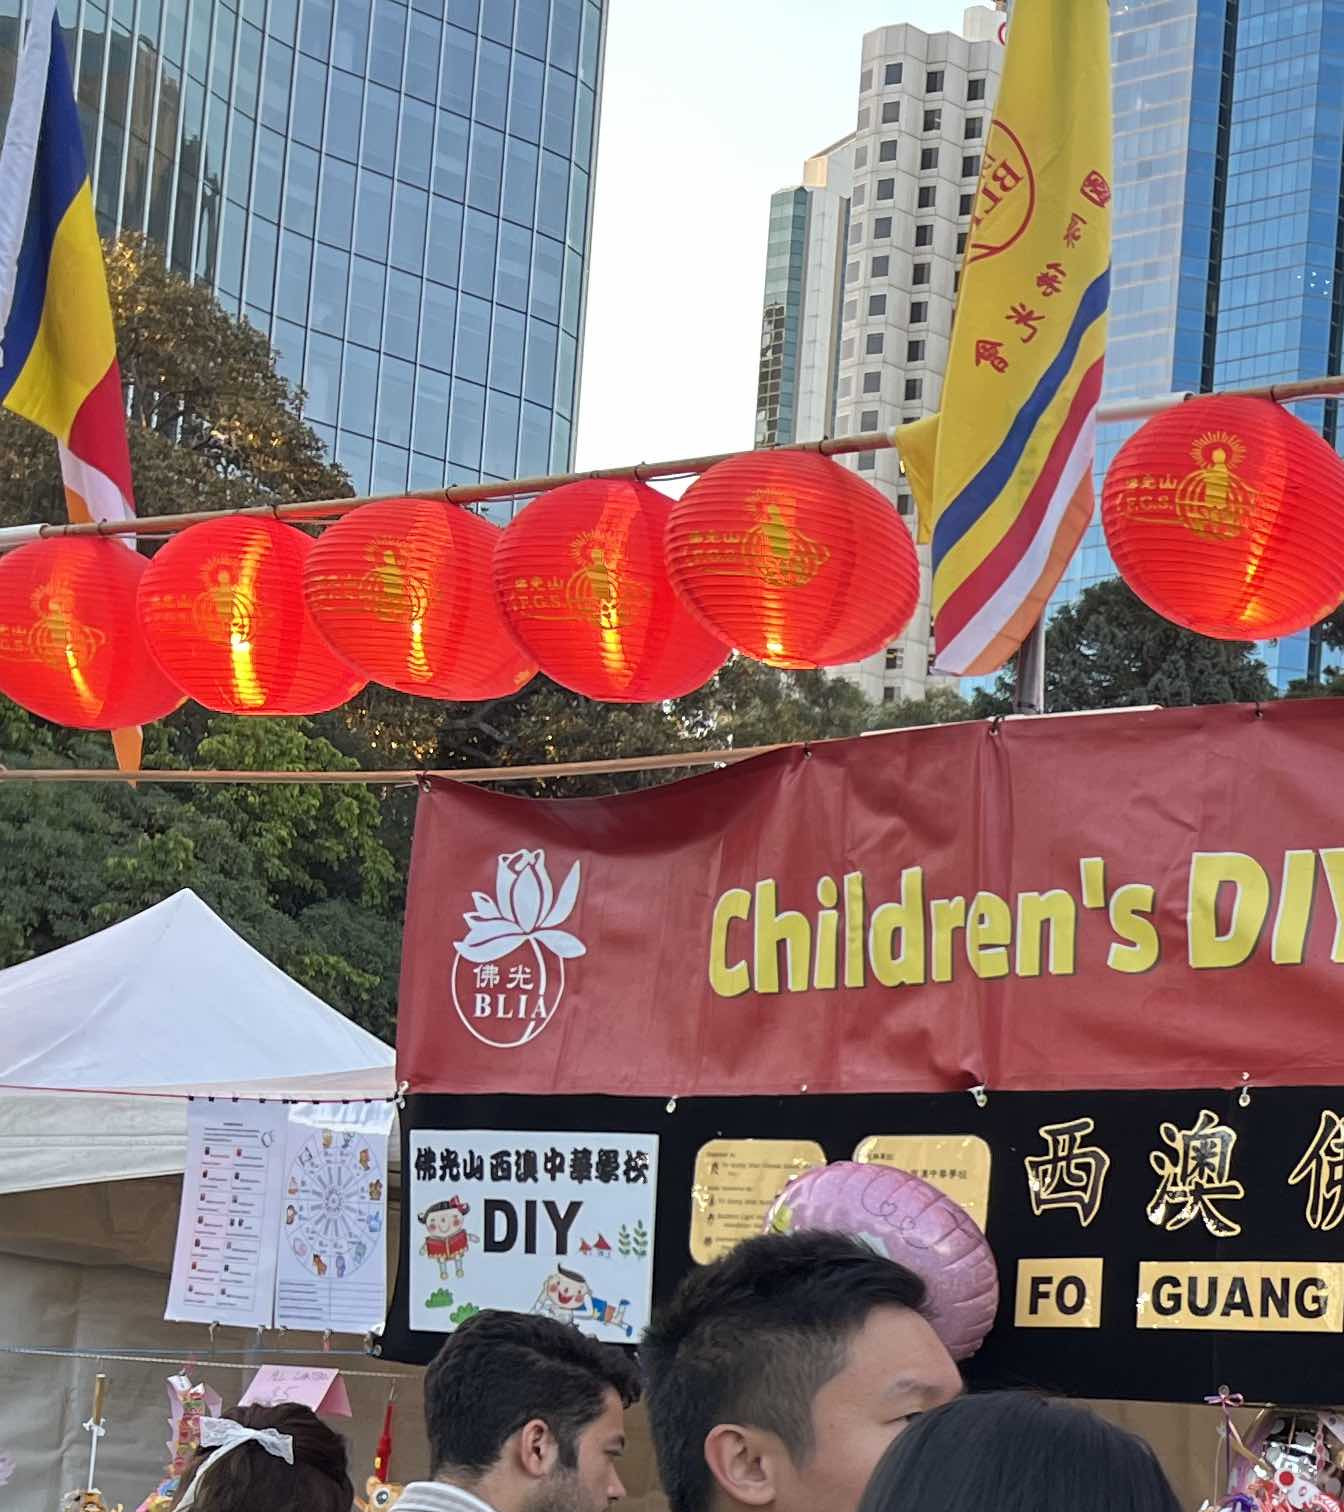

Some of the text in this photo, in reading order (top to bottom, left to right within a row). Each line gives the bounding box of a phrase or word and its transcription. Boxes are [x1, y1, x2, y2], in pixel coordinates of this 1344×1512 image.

[708, 856, 1162, 998] Children's
[473, 963, 534, 990] 佛光
[473, 992, 549, 1020] BLIA
[483, 1198, 584, 1256] DIY
[1029, 1275, 1087, 1316] FO
[1151, 1275, 1329, 1319] GUANG
